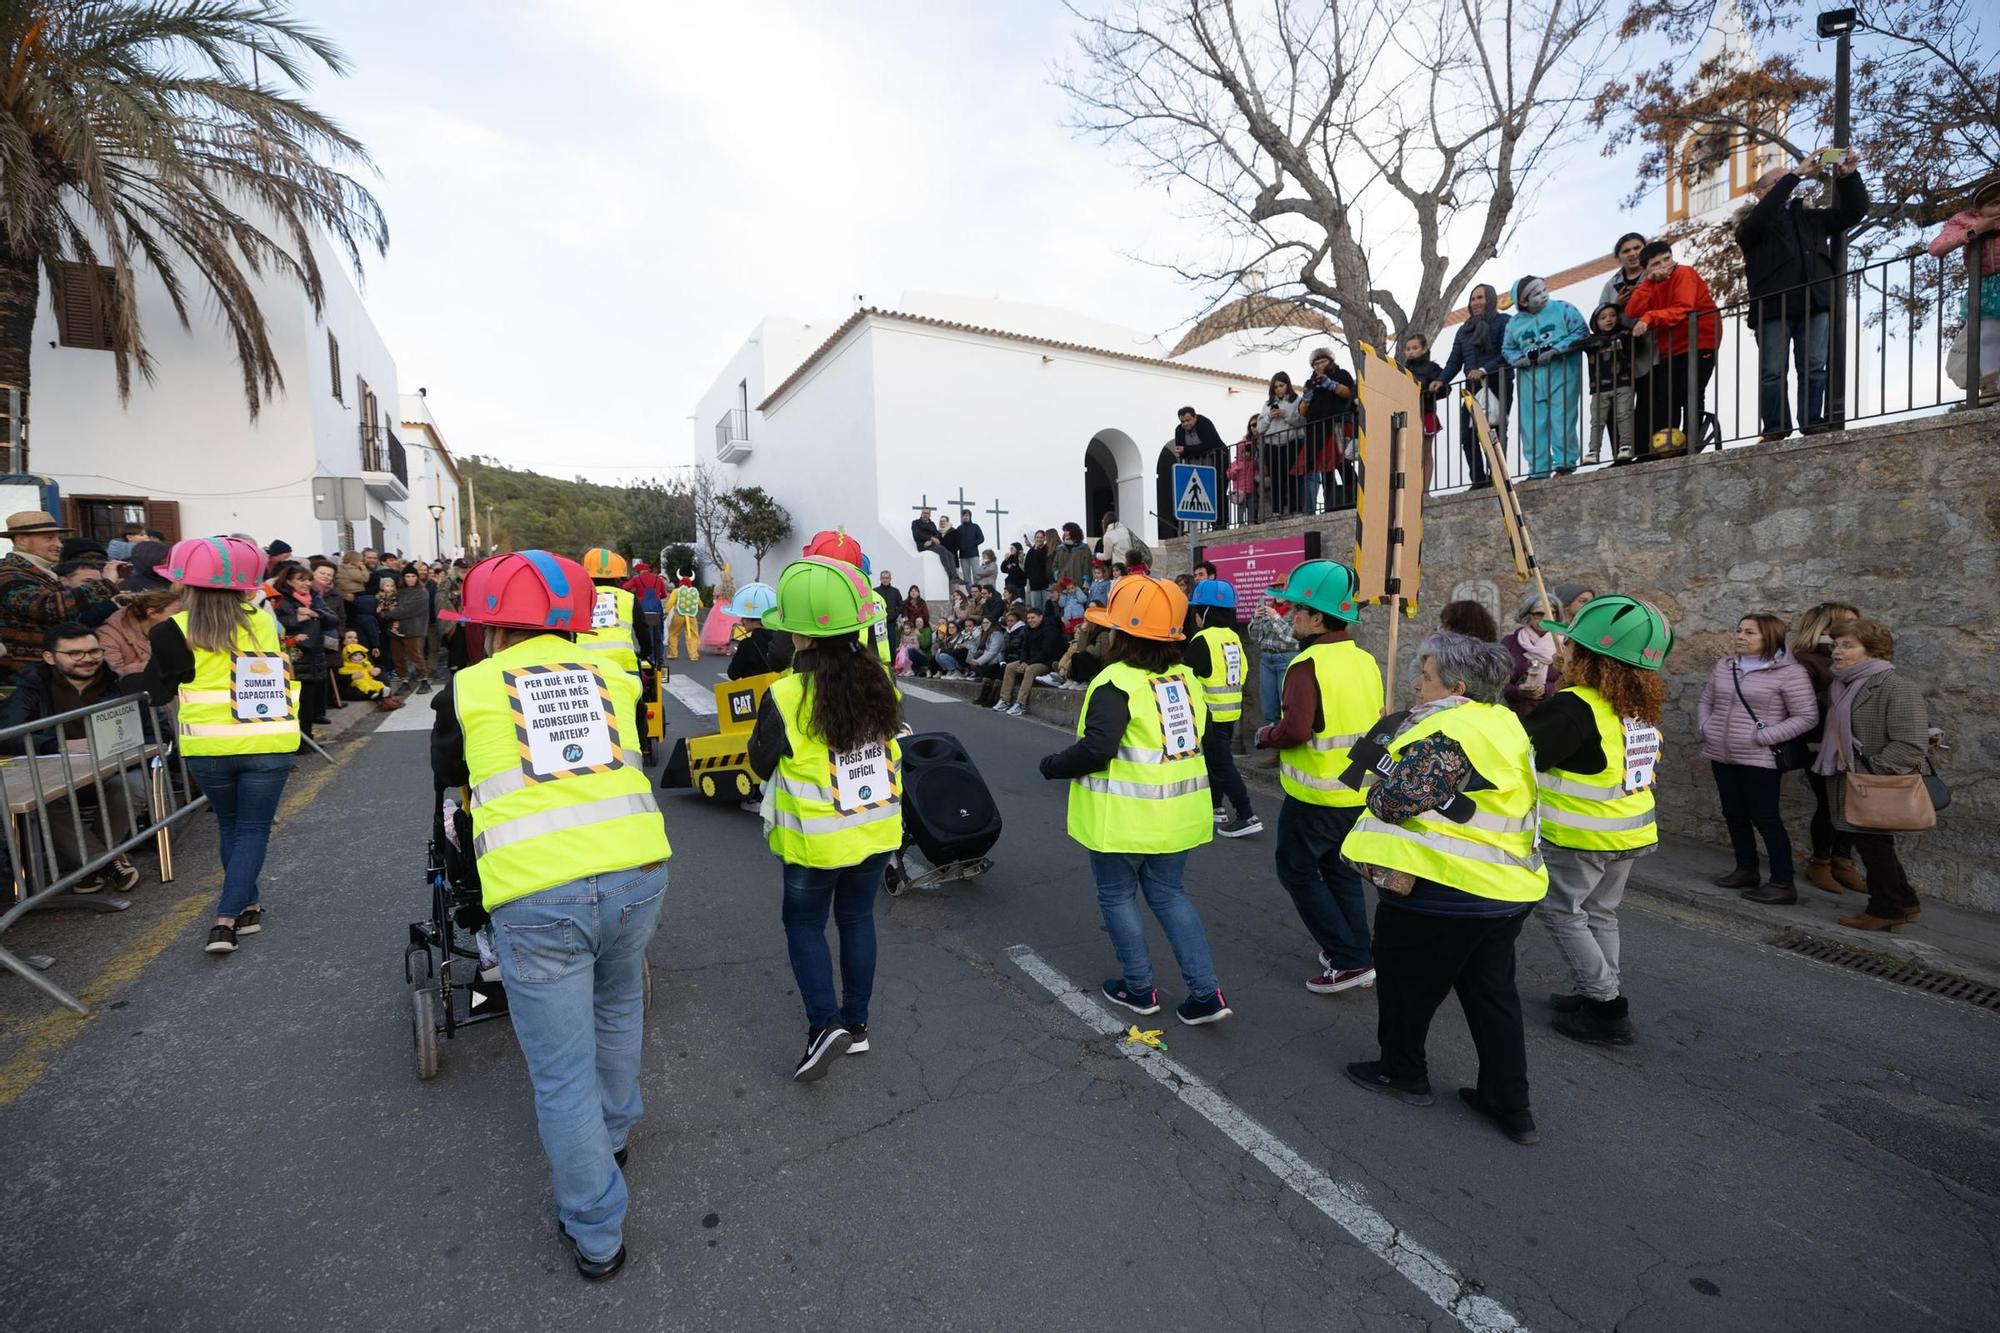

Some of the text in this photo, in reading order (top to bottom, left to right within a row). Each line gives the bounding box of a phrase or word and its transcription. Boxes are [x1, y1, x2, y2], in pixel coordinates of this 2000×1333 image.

[244, 679, 276, 688] SUMANT
[524, 675, 589, 689] PER QUÈ HE DE
[238, 690, 284, 700] CAPACITATS
[530, 685, 589, 701] LLUITAR MÉS
[119, 704, 136, 716] LOCAL
[538, 699, 589, 714] QUE TU PER
[733, 694, 752, 715] CAT
[532, 711, 601, 729] ACONSEGUIR EL
[549, 727, 590, 742] MATEIX?
[1636, 732, 1656, 743] IMPORTA
[839, 745, 882, 766] POSIS MÉS
[848, 763, 876, 780] DIFÍCIL
